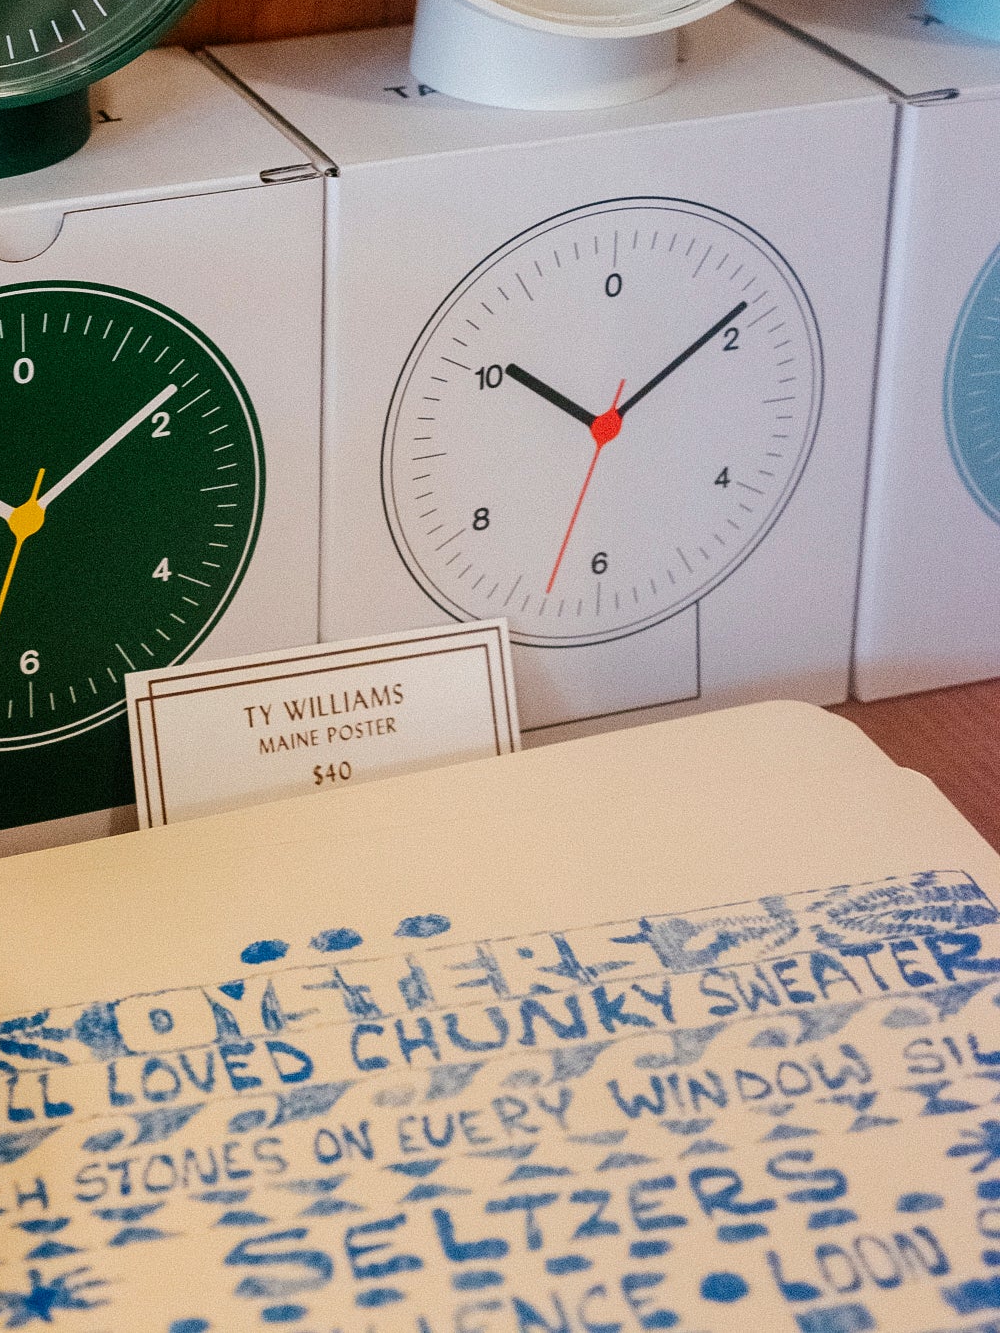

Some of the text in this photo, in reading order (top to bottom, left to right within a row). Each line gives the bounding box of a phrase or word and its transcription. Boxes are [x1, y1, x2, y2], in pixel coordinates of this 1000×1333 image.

[604, 273, 622, 297] 0
[723, 328, 739, 351] 2
[13, 358, 34, 384] 0
[475, 365, 502, 389] 10
[152, 413, 171, 438] 2
[714, 468, 731, 488] 4
[473, 508, 489, 530] 8
[153, 558, 172, 581] 4
[592, 552, 608, 574] 6
[20, 650, 40, 674] 6
[244, 683, 405, 728] TY WILLIAMS
[259, 717, 397, 755] MAINE POSTER
[313, 761, 352, 786] $40
[106, 1040, 315, 1107] LOVED
[350, 978, 677, 1072] CHUNKY
[701, 932, 1000, 1017] SWEATER
[74, 1136, 289, 1203] STONES
[312, 1119, 375, 1165] ON
[607, 1043, 873, 1119] WINDOW
[223, 1149, 849, 1297] SELTZERS
[766, 1225, 951, 1302] LOON
